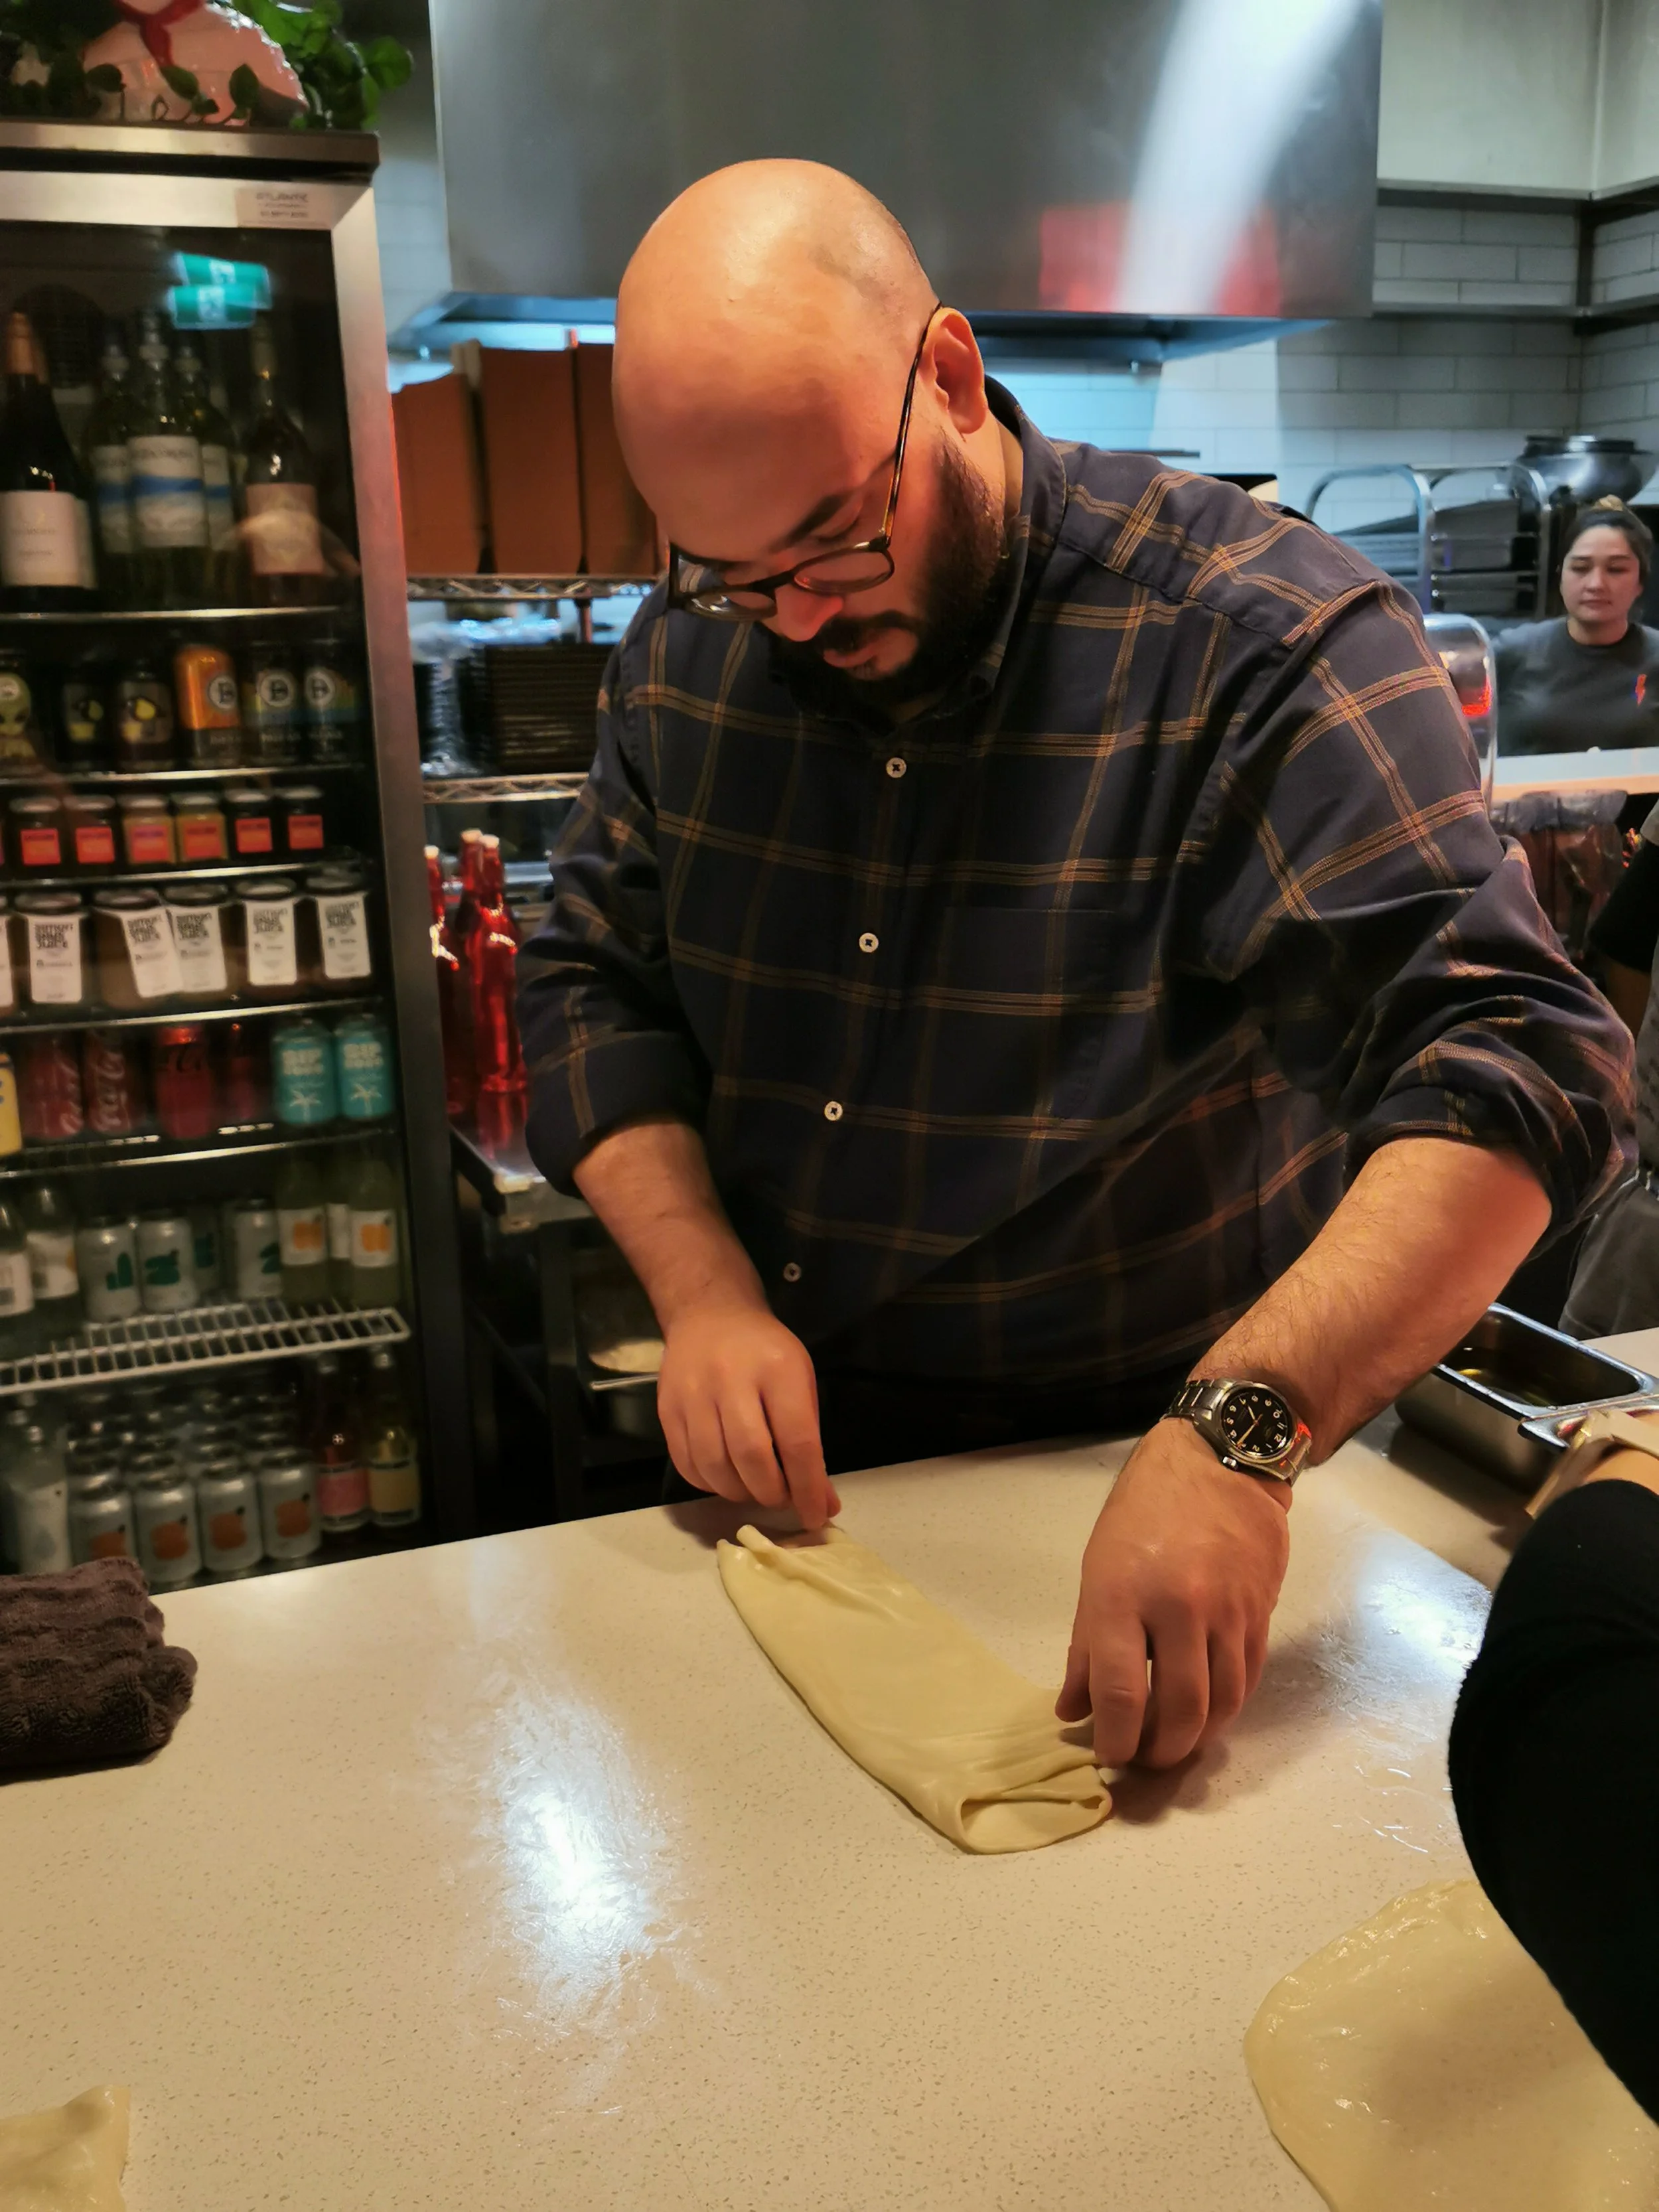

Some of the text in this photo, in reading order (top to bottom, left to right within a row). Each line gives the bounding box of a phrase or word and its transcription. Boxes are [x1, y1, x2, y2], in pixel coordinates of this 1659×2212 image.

[1273, 1409, 1283, 1418] 10
[1230, 1430, 1237, 1438] 4
[1274, 1434, 1283, 1442] 12
